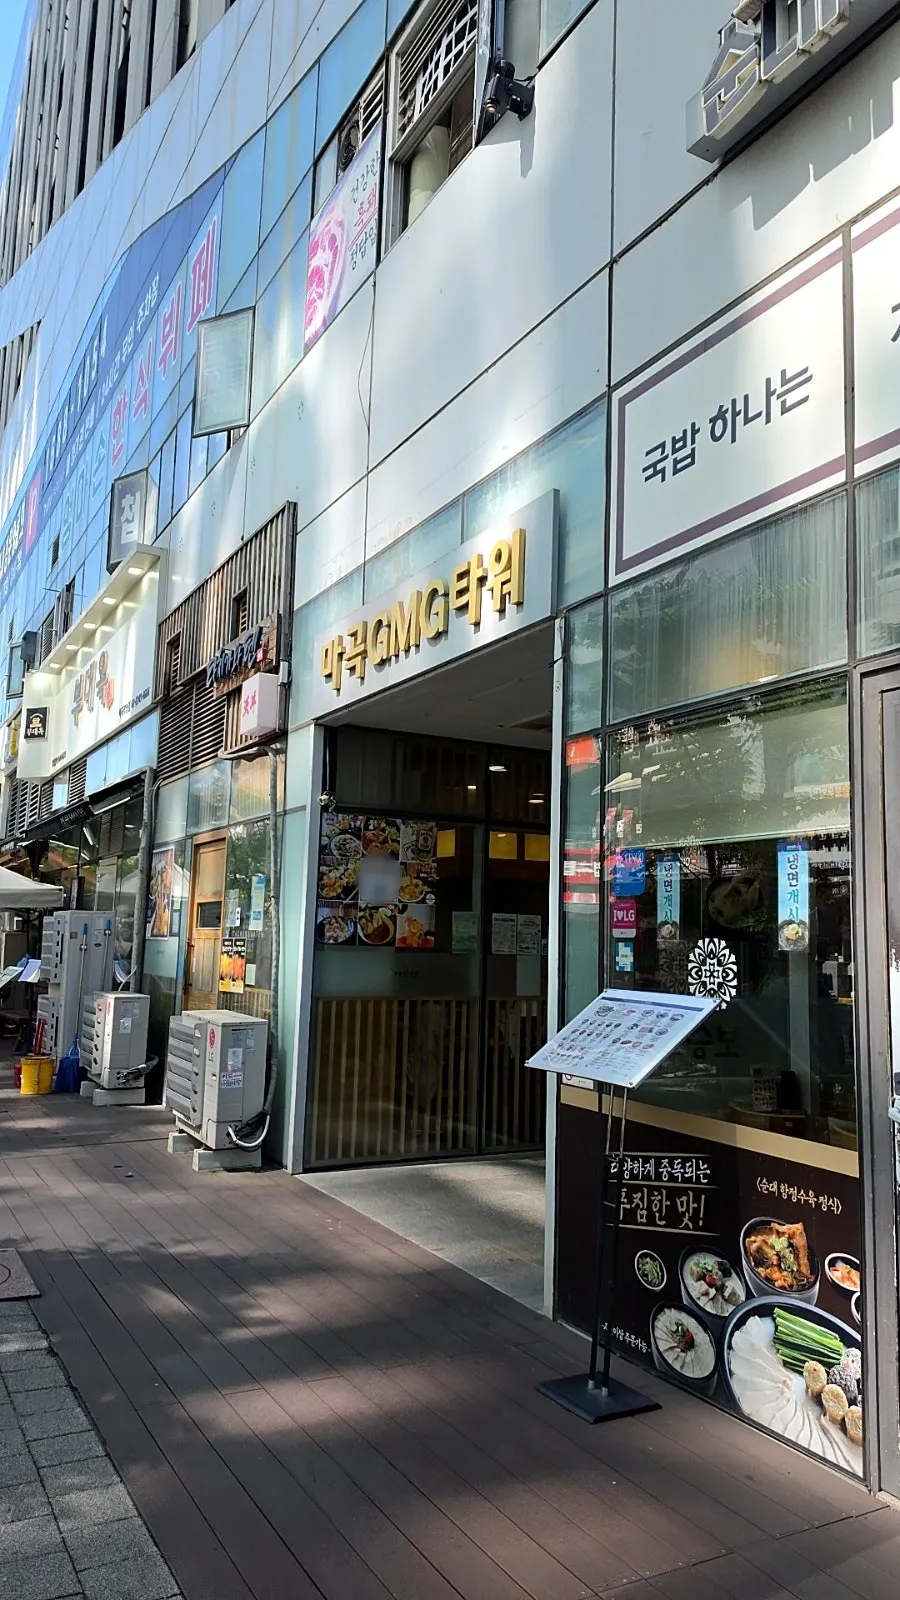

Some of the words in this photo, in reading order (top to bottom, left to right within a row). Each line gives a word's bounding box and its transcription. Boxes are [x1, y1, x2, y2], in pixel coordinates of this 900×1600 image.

[641, 420, 700, 484] 국밥
[708, 365, 814, 445] 하나는
[658, 1158, 711, 1183] 중독되는
[676, 1190, 706, 1230] 맛!
